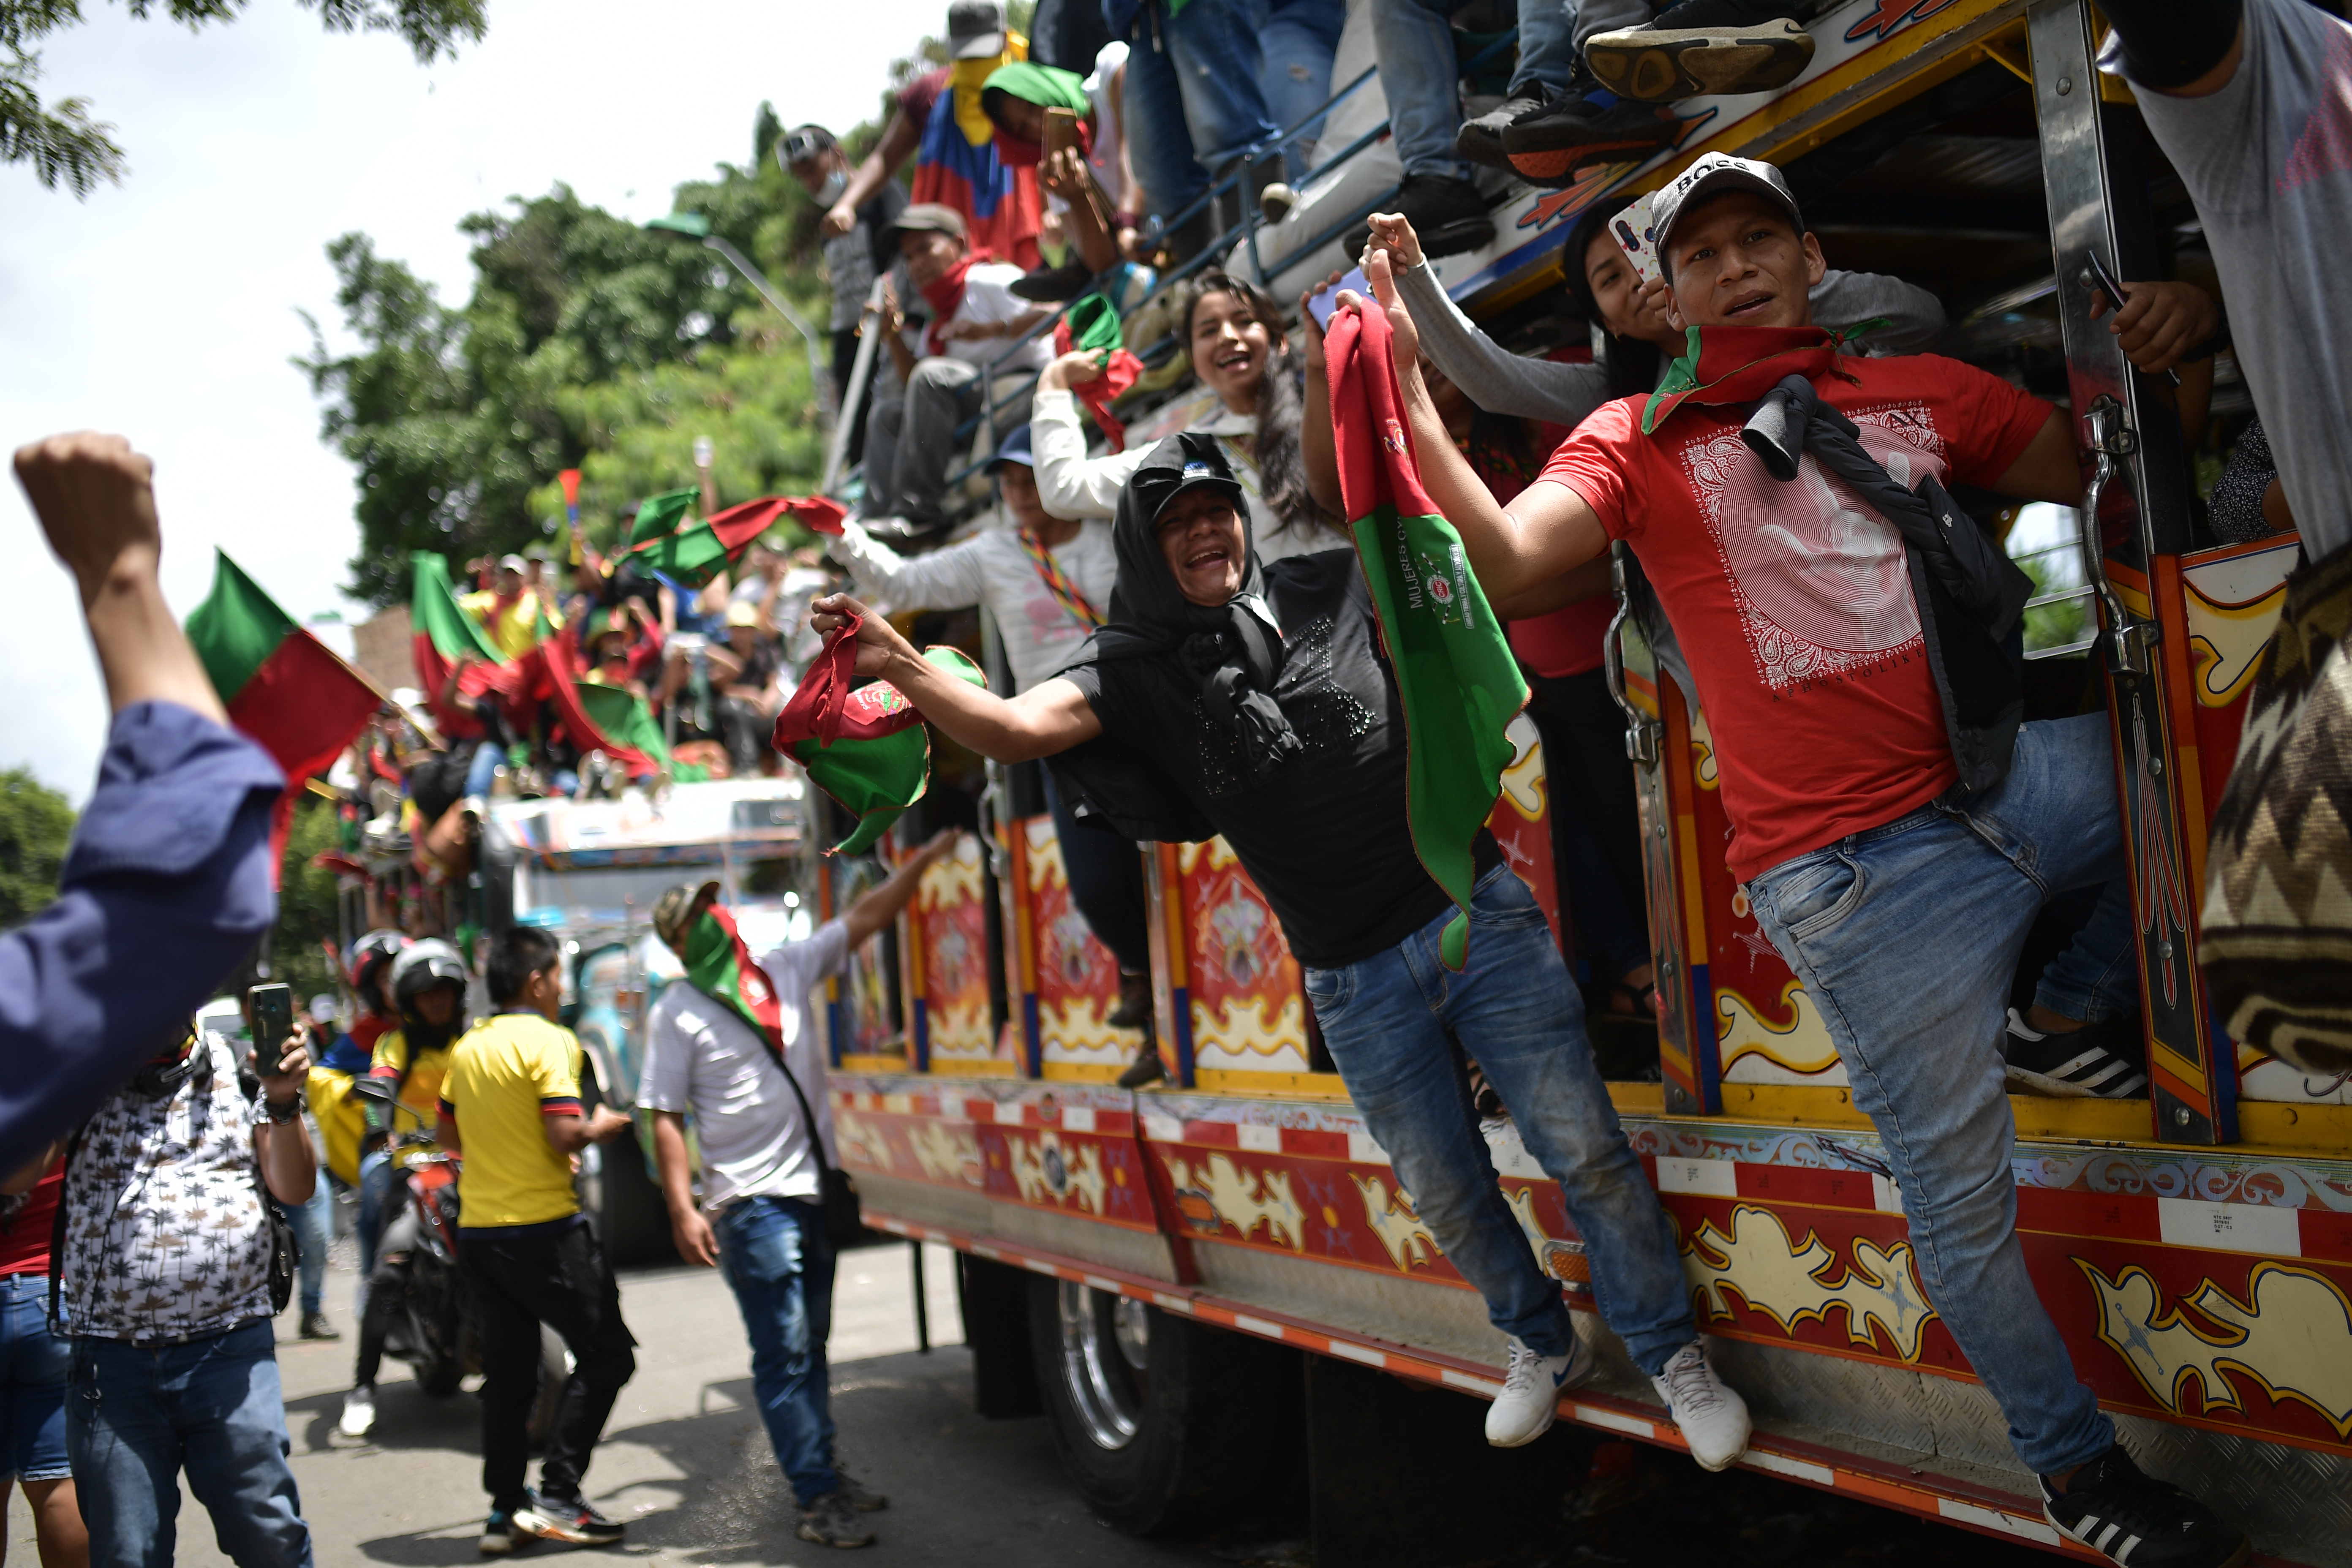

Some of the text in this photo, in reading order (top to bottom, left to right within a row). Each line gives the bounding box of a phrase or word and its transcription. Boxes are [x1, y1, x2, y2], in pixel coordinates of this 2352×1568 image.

[1398, 545, 1423, 609] MUJERES
[1435, 581, 1445, 598] CRIC
[1773, 648, 1923, 702] APHOSTOLIKE
